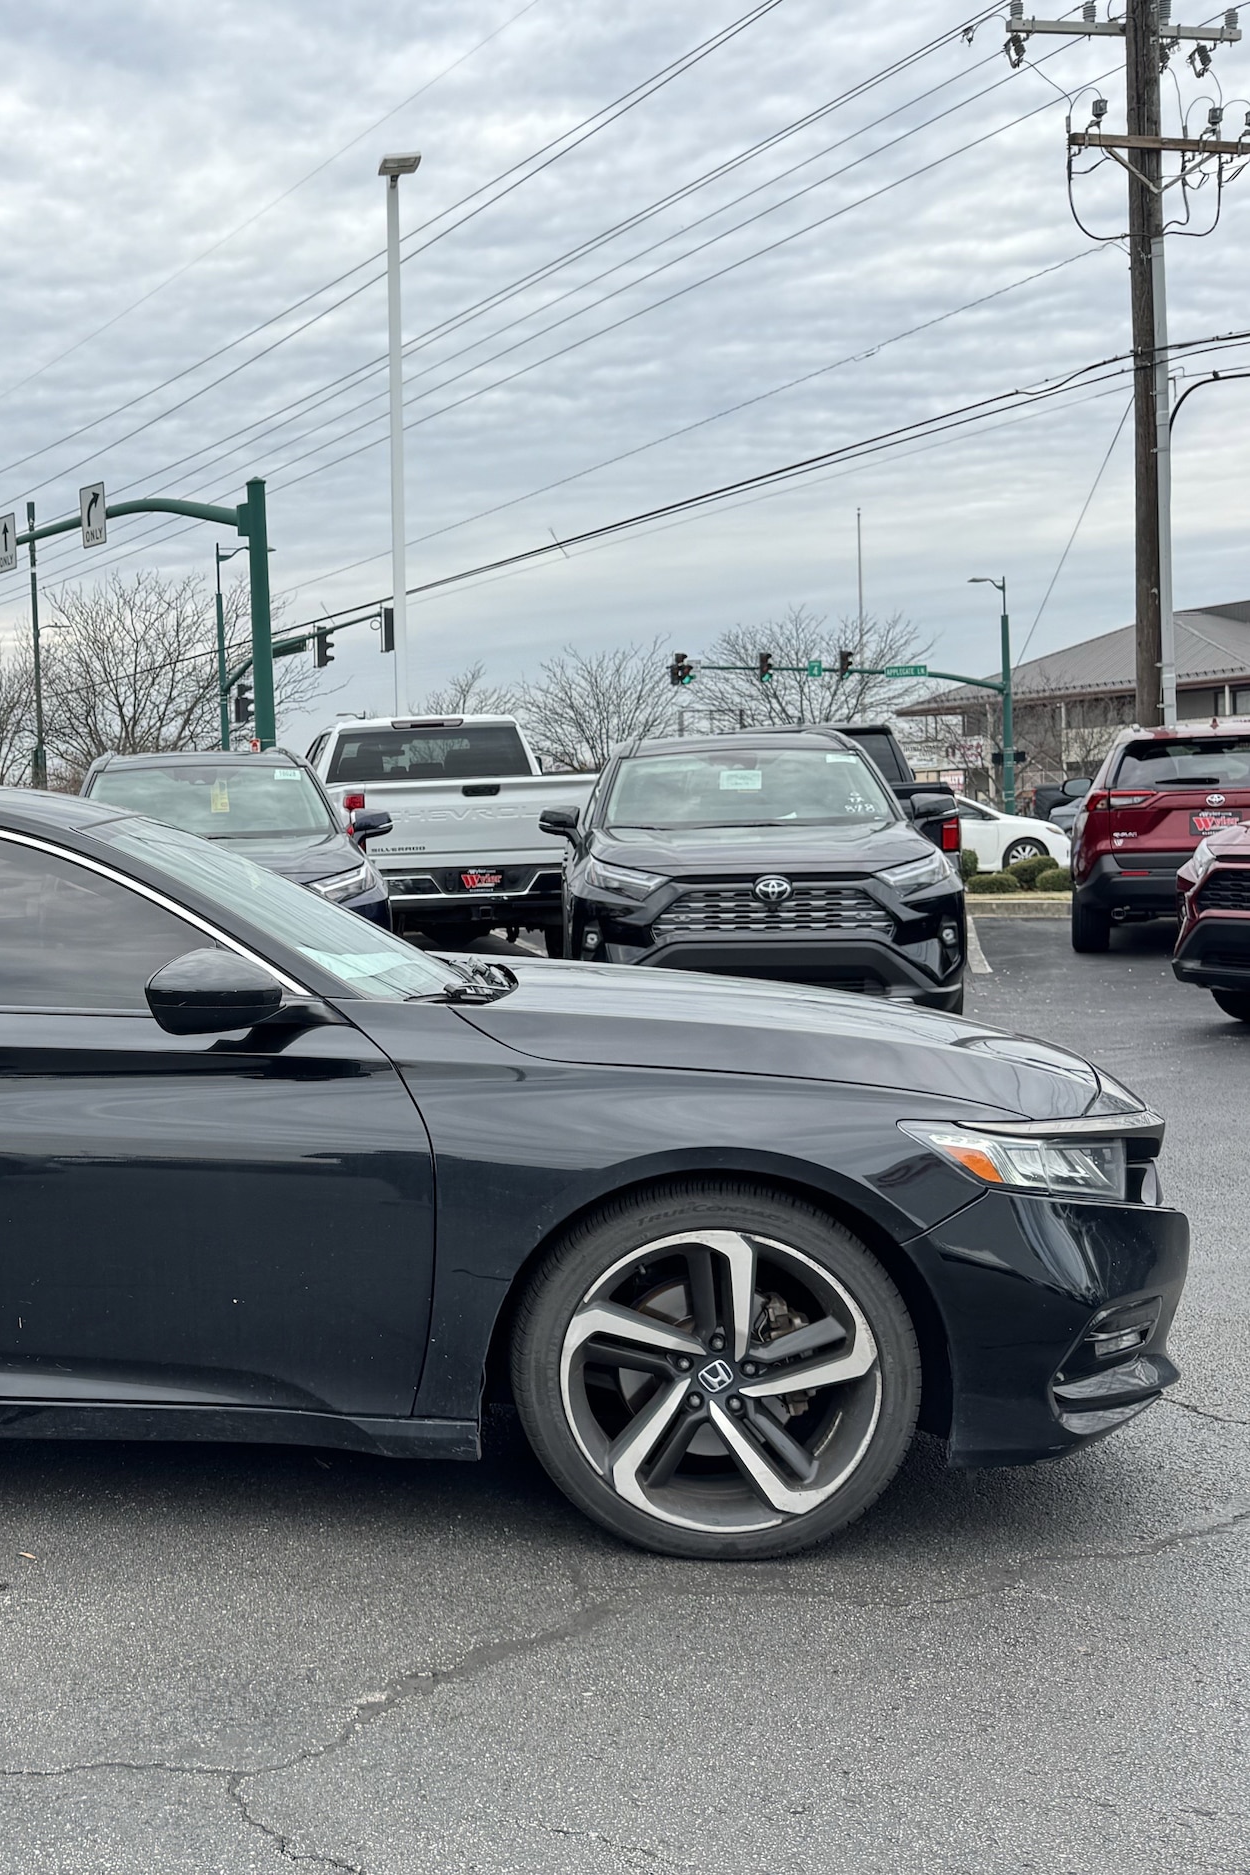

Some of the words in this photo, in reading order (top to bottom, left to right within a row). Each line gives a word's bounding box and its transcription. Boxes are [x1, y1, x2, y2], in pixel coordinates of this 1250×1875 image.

[86, 528, 103, 543] ONLY
[0, 556, 13, 568] ONLY
[461, 873, 502, 889] Wyler
